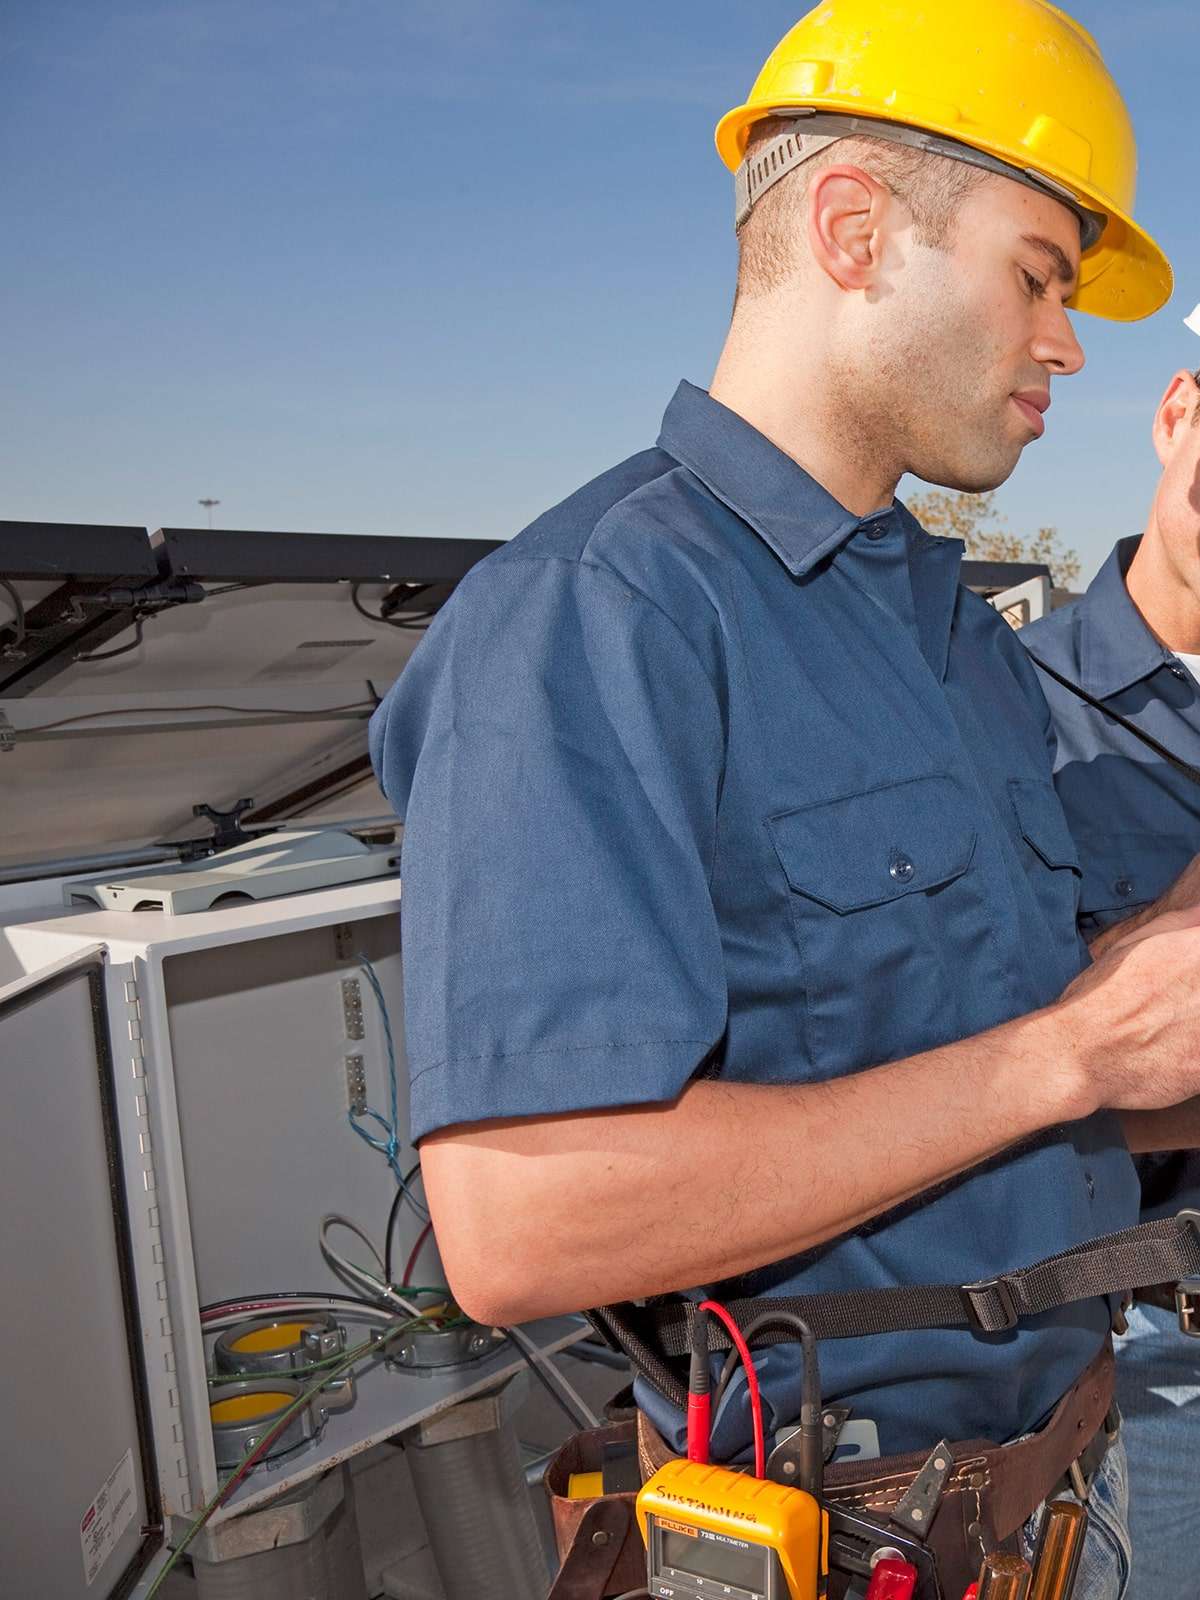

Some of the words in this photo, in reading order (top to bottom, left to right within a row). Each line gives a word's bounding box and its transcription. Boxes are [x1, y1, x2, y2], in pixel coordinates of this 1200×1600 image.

[661, 1519, 695, 1535] FLUKE
[715, 1534, 749, 1549] MULTIMETER
[659, 1587, 674, 1597] OFF
